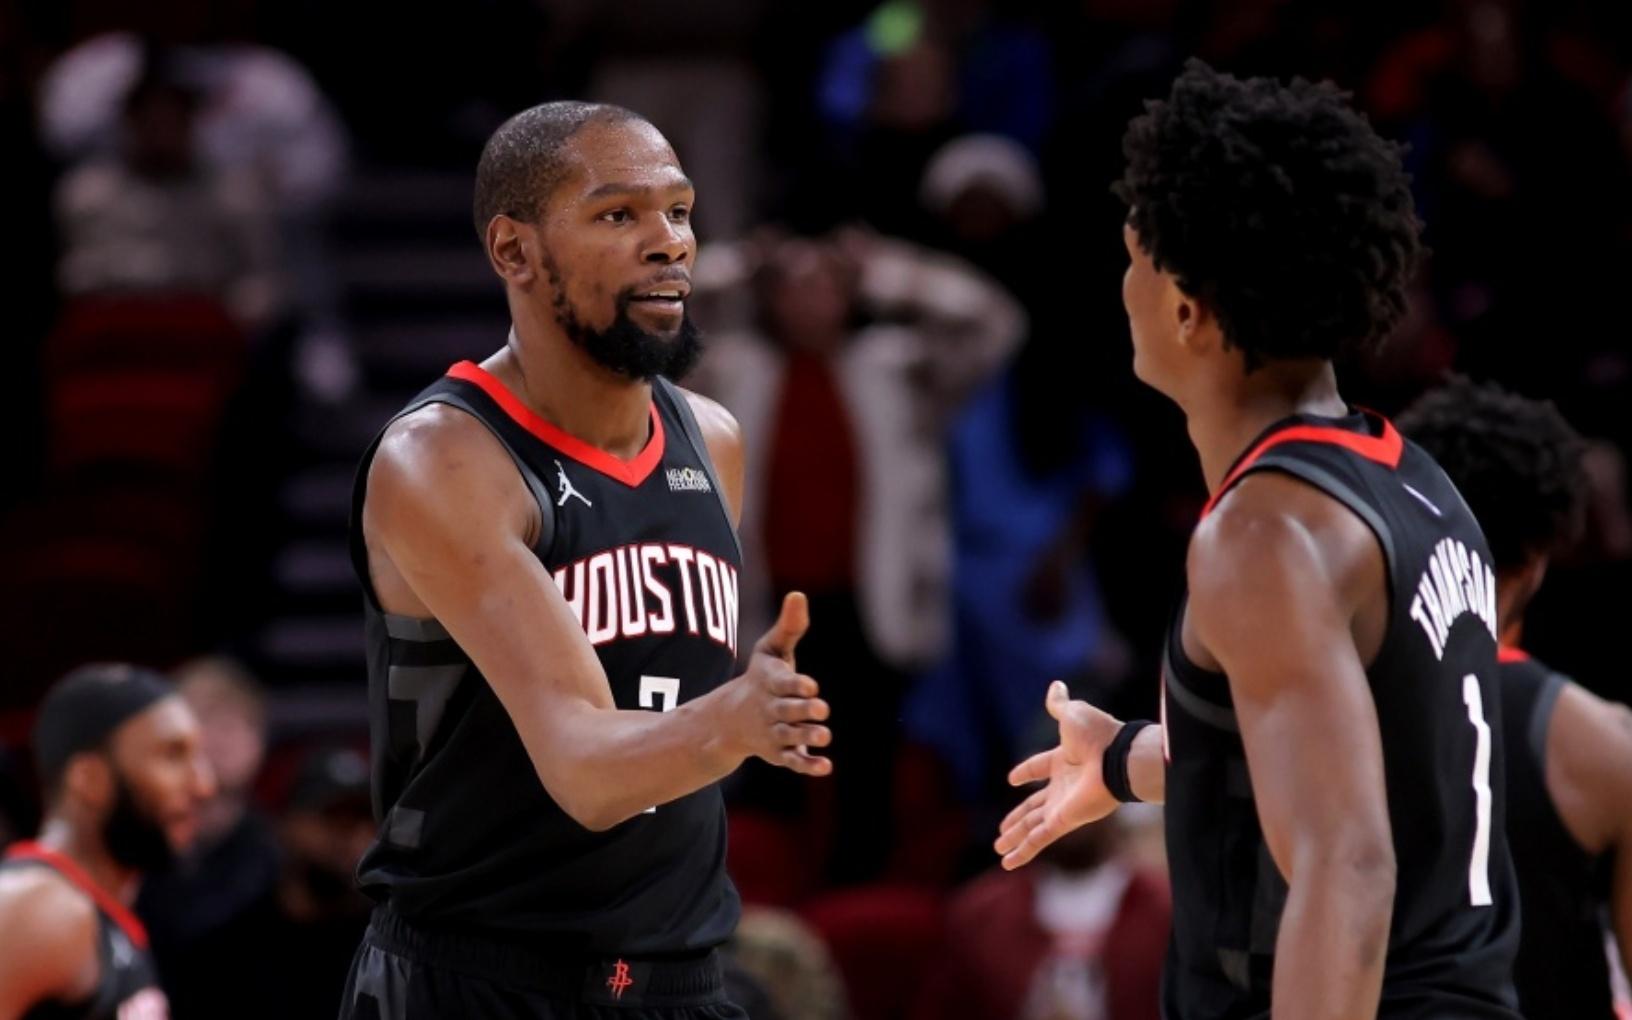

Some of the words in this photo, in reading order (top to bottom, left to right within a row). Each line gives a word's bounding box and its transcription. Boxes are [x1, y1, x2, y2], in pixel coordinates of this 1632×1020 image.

[553, 543, 738, 660] HOUSTON
[1410, 536, 1498, 662] THOMPSON
[1463, 674, 1493, 906] 1
